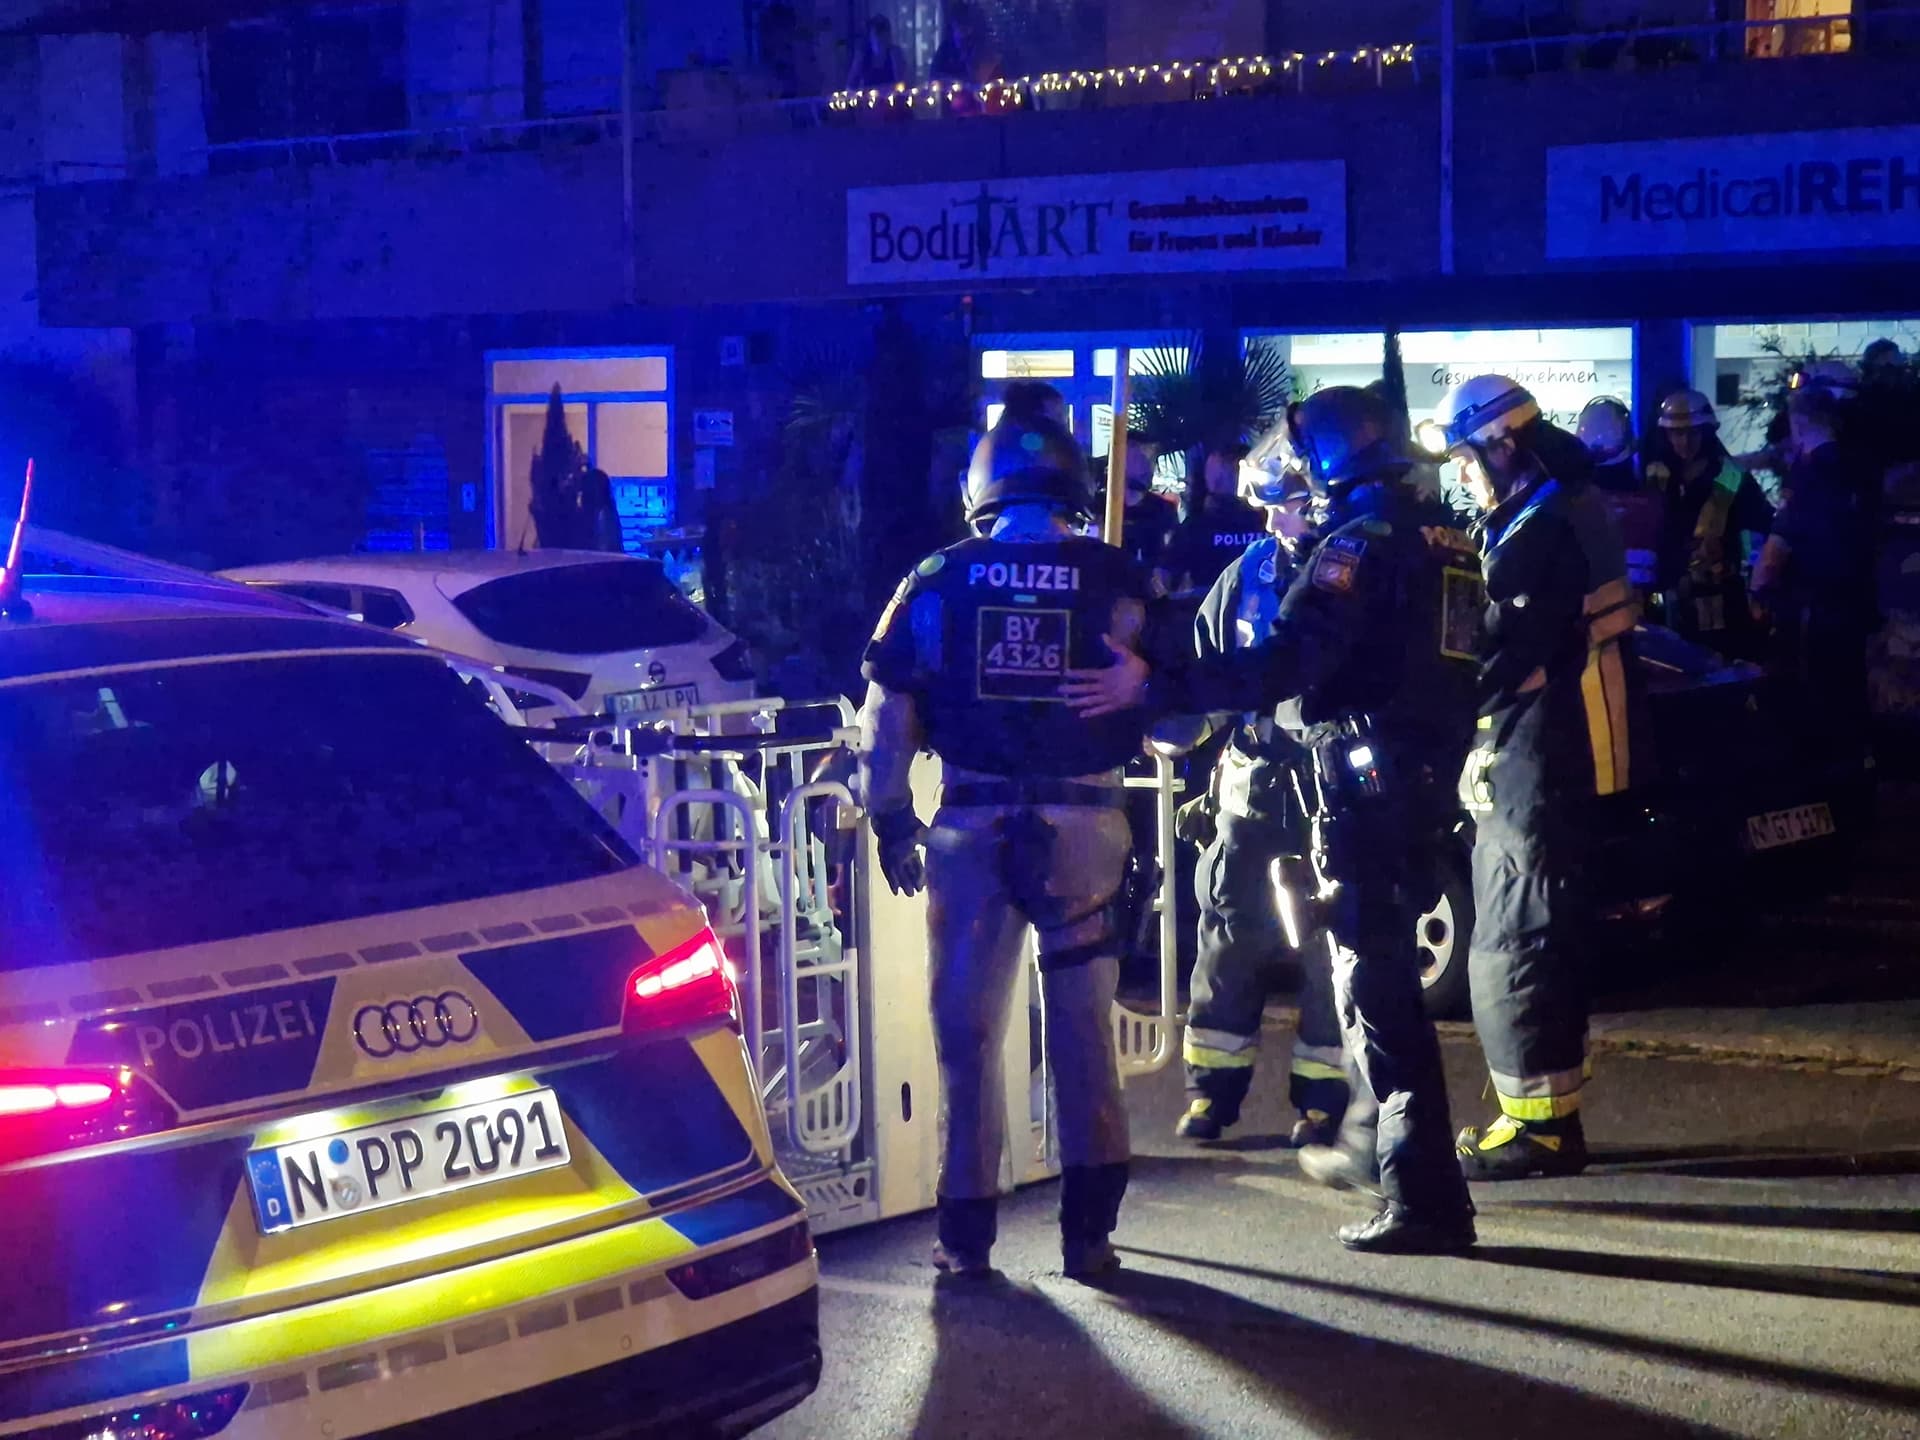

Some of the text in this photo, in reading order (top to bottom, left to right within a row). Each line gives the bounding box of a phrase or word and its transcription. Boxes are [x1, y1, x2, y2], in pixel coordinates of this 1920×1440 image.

[968, 562, 1081, 590] POLIZEI
[1006, 615, 1040, 641] BY
[986, 641, 1060, 669] 4326
[135, 1000, 315, 1066] POLIZEI
[283, 1100, 564, 1219] N PP 2091
[267, 1199, 281, 1218] D
